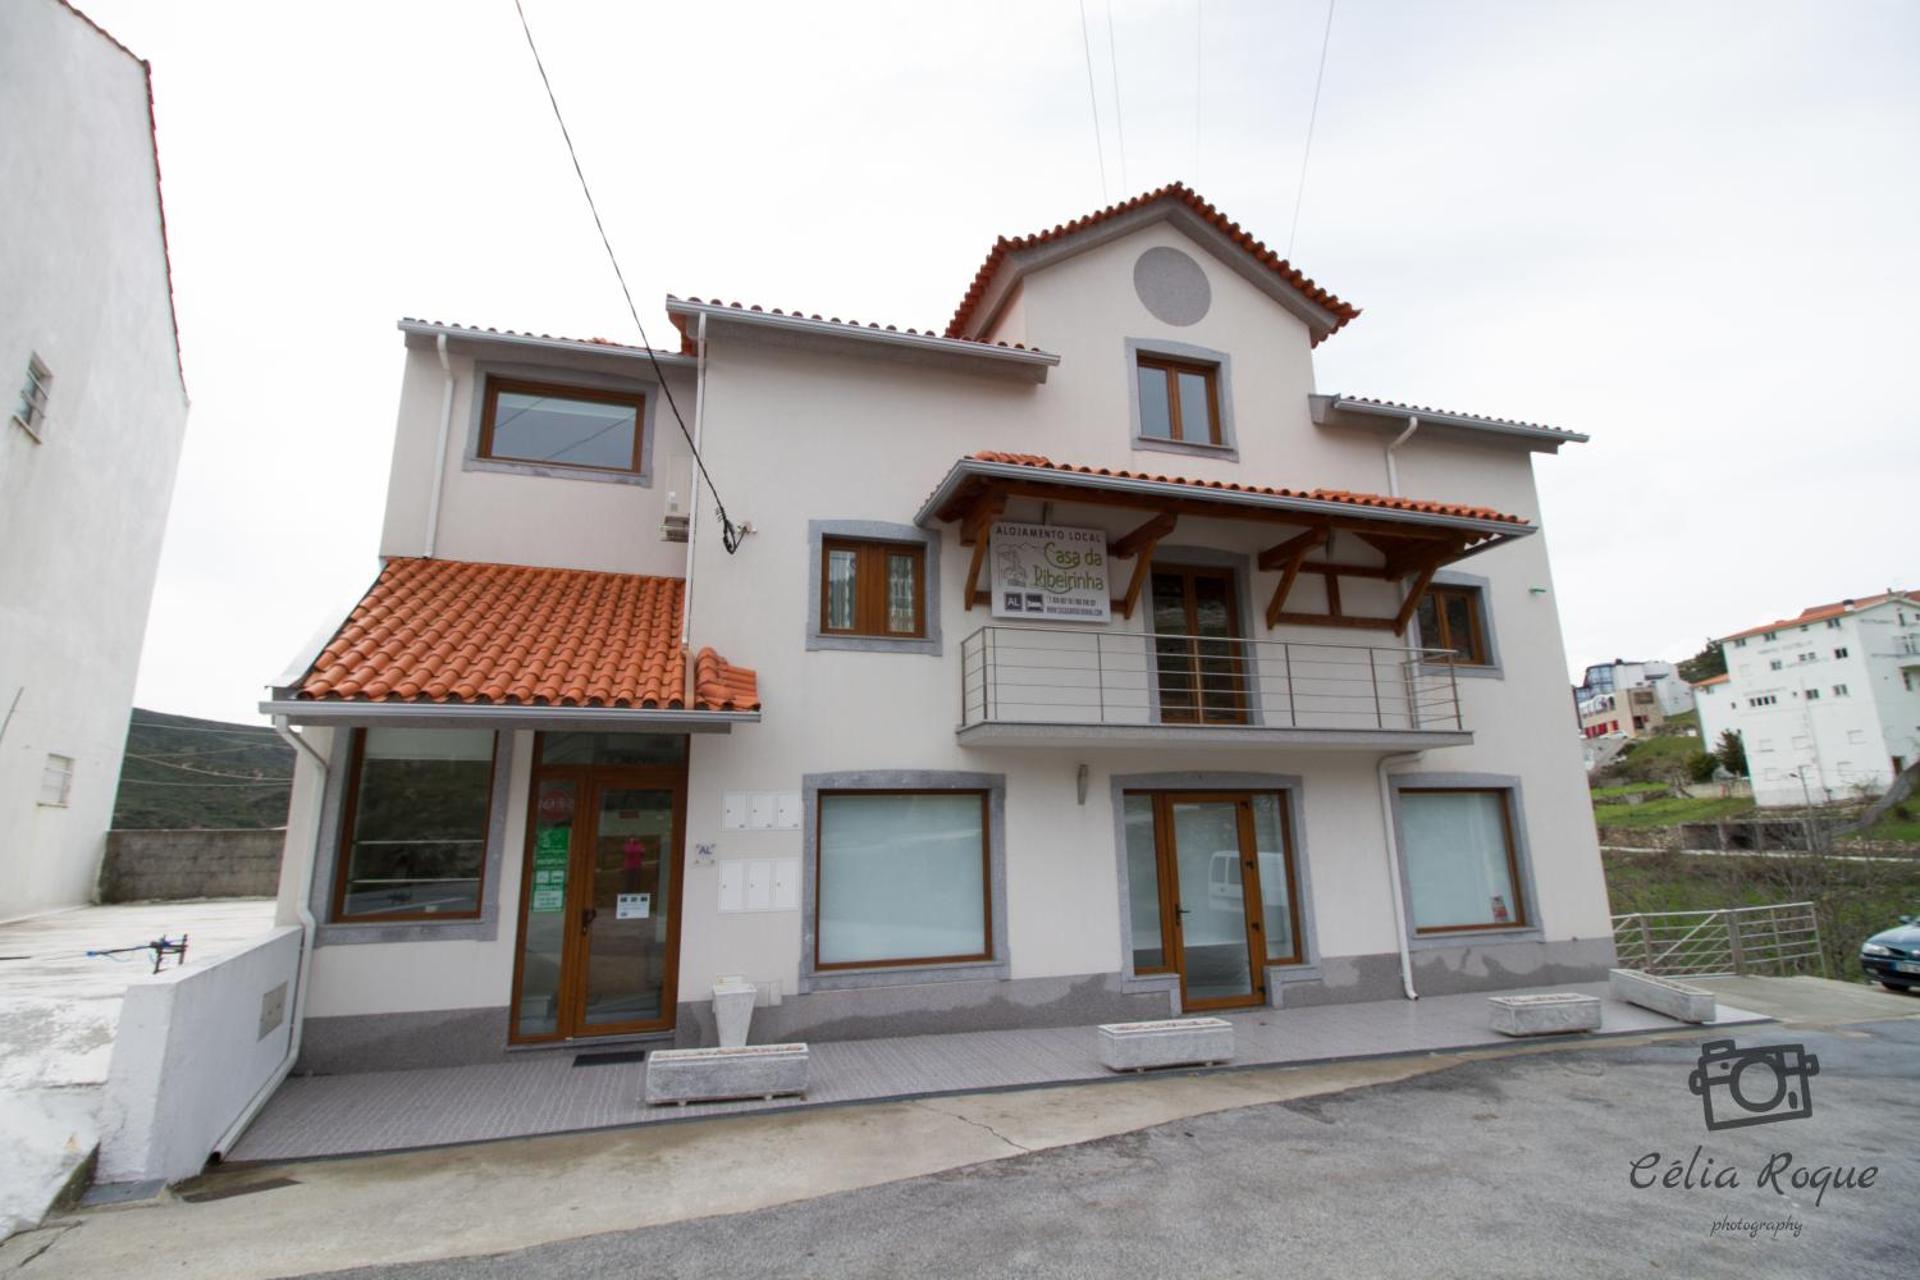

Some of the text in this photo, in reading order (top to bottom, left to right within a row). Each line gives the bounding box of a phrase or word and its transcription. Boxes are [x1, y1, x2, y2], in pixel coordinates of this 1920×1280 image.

[996, 526, 1101, 543] ALOJAMENTO LOCAL
[1044, 542, 1103, 570] Casa da
